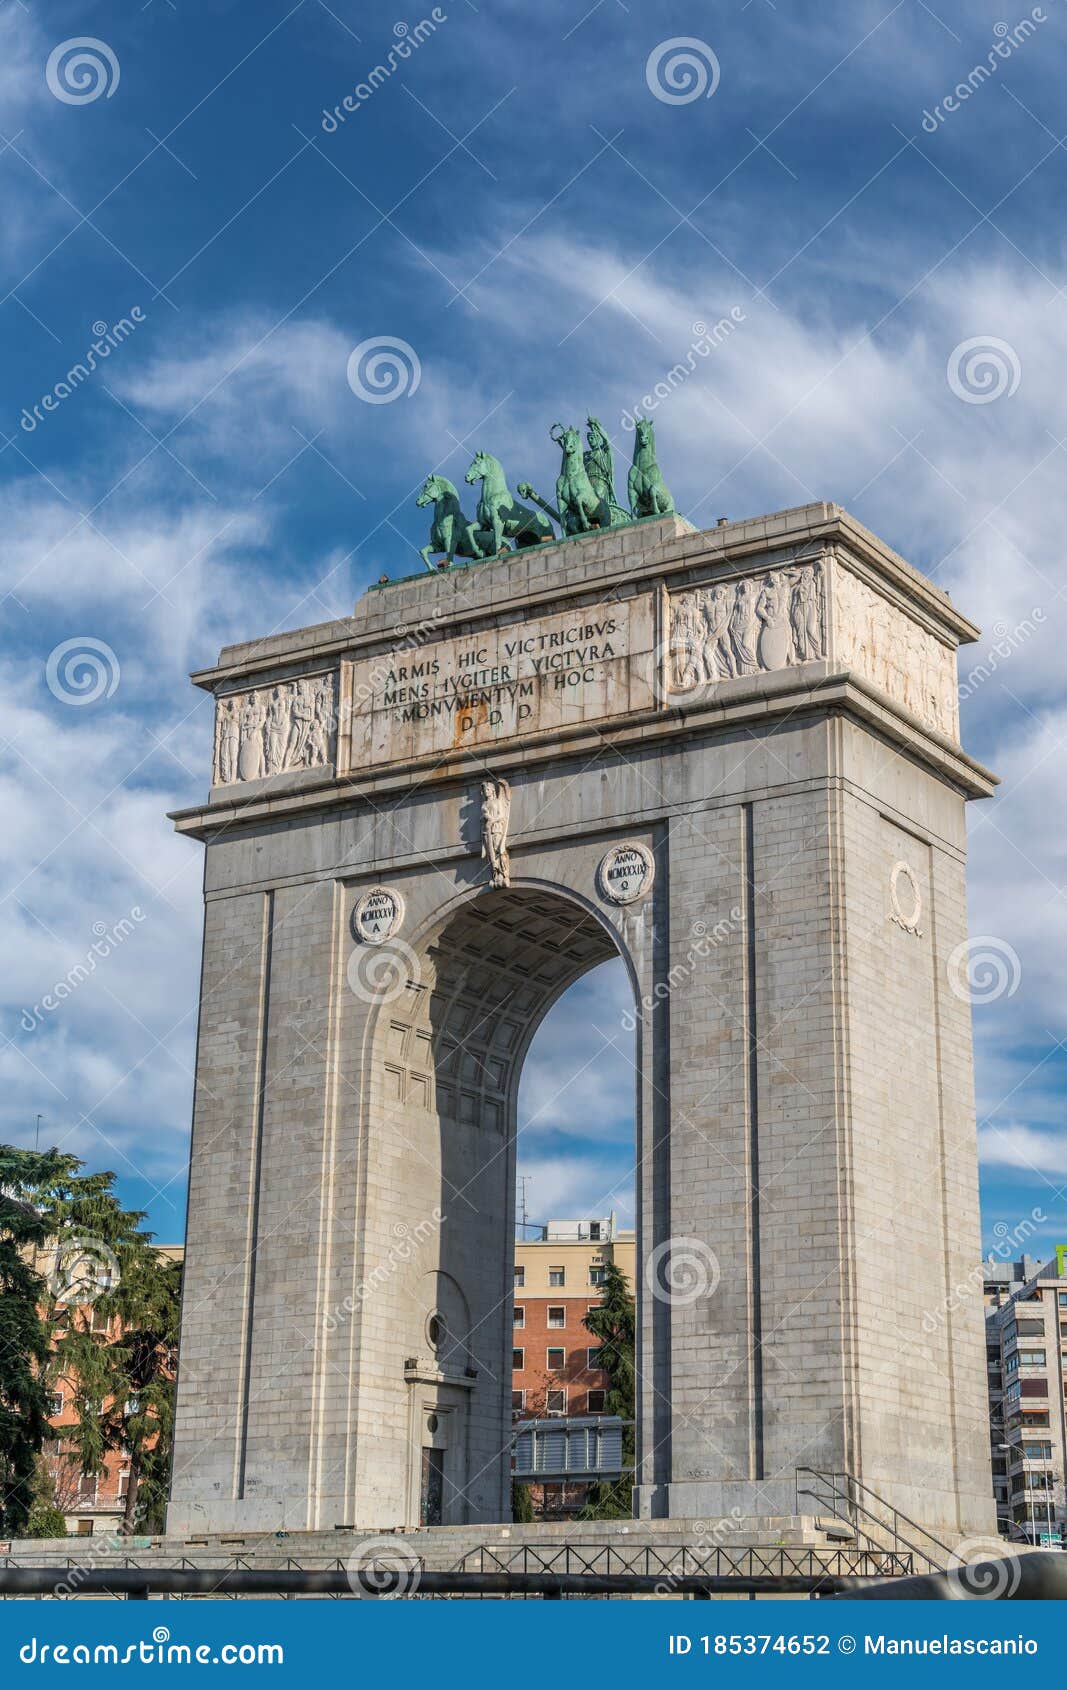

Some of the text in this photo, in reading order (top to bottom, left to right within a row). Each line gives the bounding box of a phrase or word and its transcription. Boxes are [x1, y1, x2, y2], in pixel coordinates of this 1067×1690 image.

[386, 619, 616, 684] ARMIS HIC VICTRICIBVS
[384, 683, 429, 706] MENS
[531, 642, 616, 673] VICTVRA
[554, 668, 595, 690] HOC
[614, 852, 637, 865] ANNO
[367, 896, 388, 907] ANNO
[372, 923, 381, 933] A
